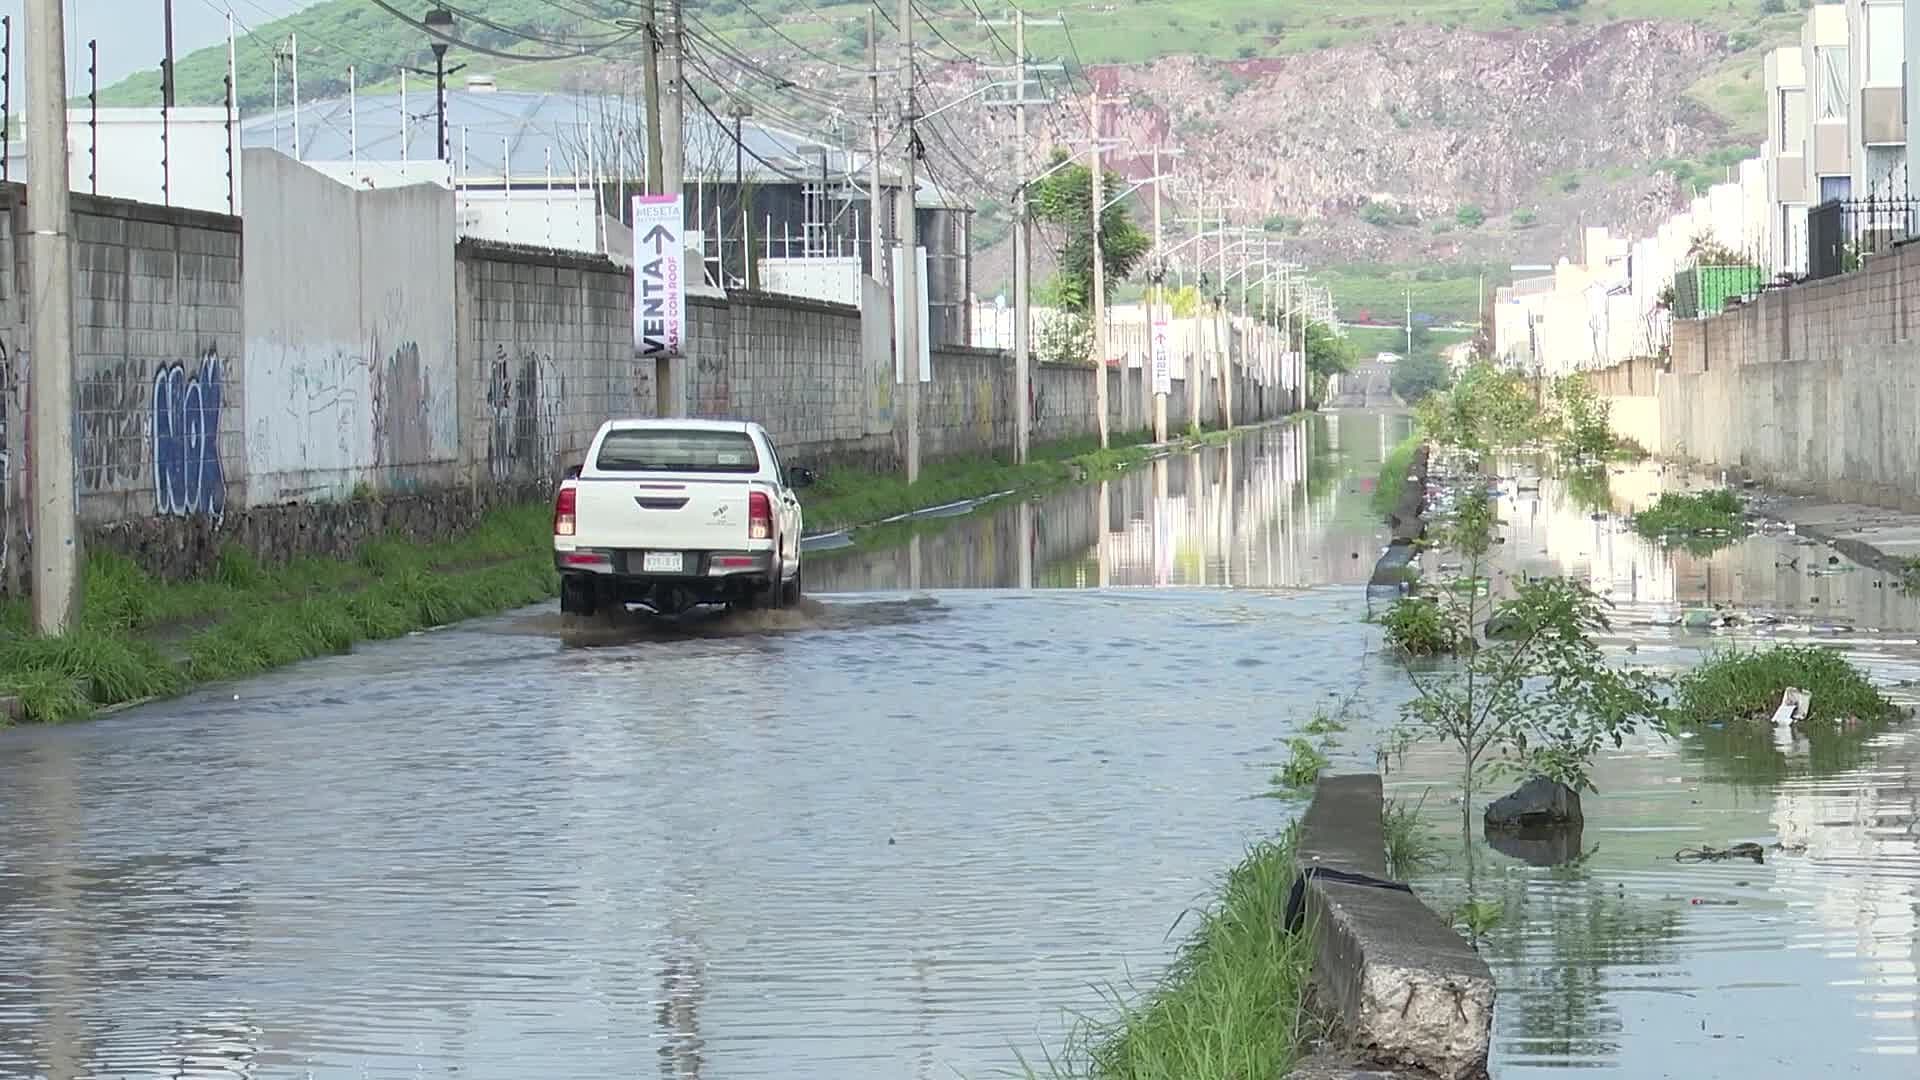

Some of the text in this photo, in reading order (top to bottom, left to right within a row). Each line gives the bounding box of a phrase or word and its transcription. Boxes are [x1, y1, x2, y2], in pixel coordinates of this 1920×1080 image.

[637, 206, 680, 216] MESETA
[667, 256, 678, 289] ROOF
[643, 257, 664, 355] VENTA
[668, 293, 678, 318] CON
